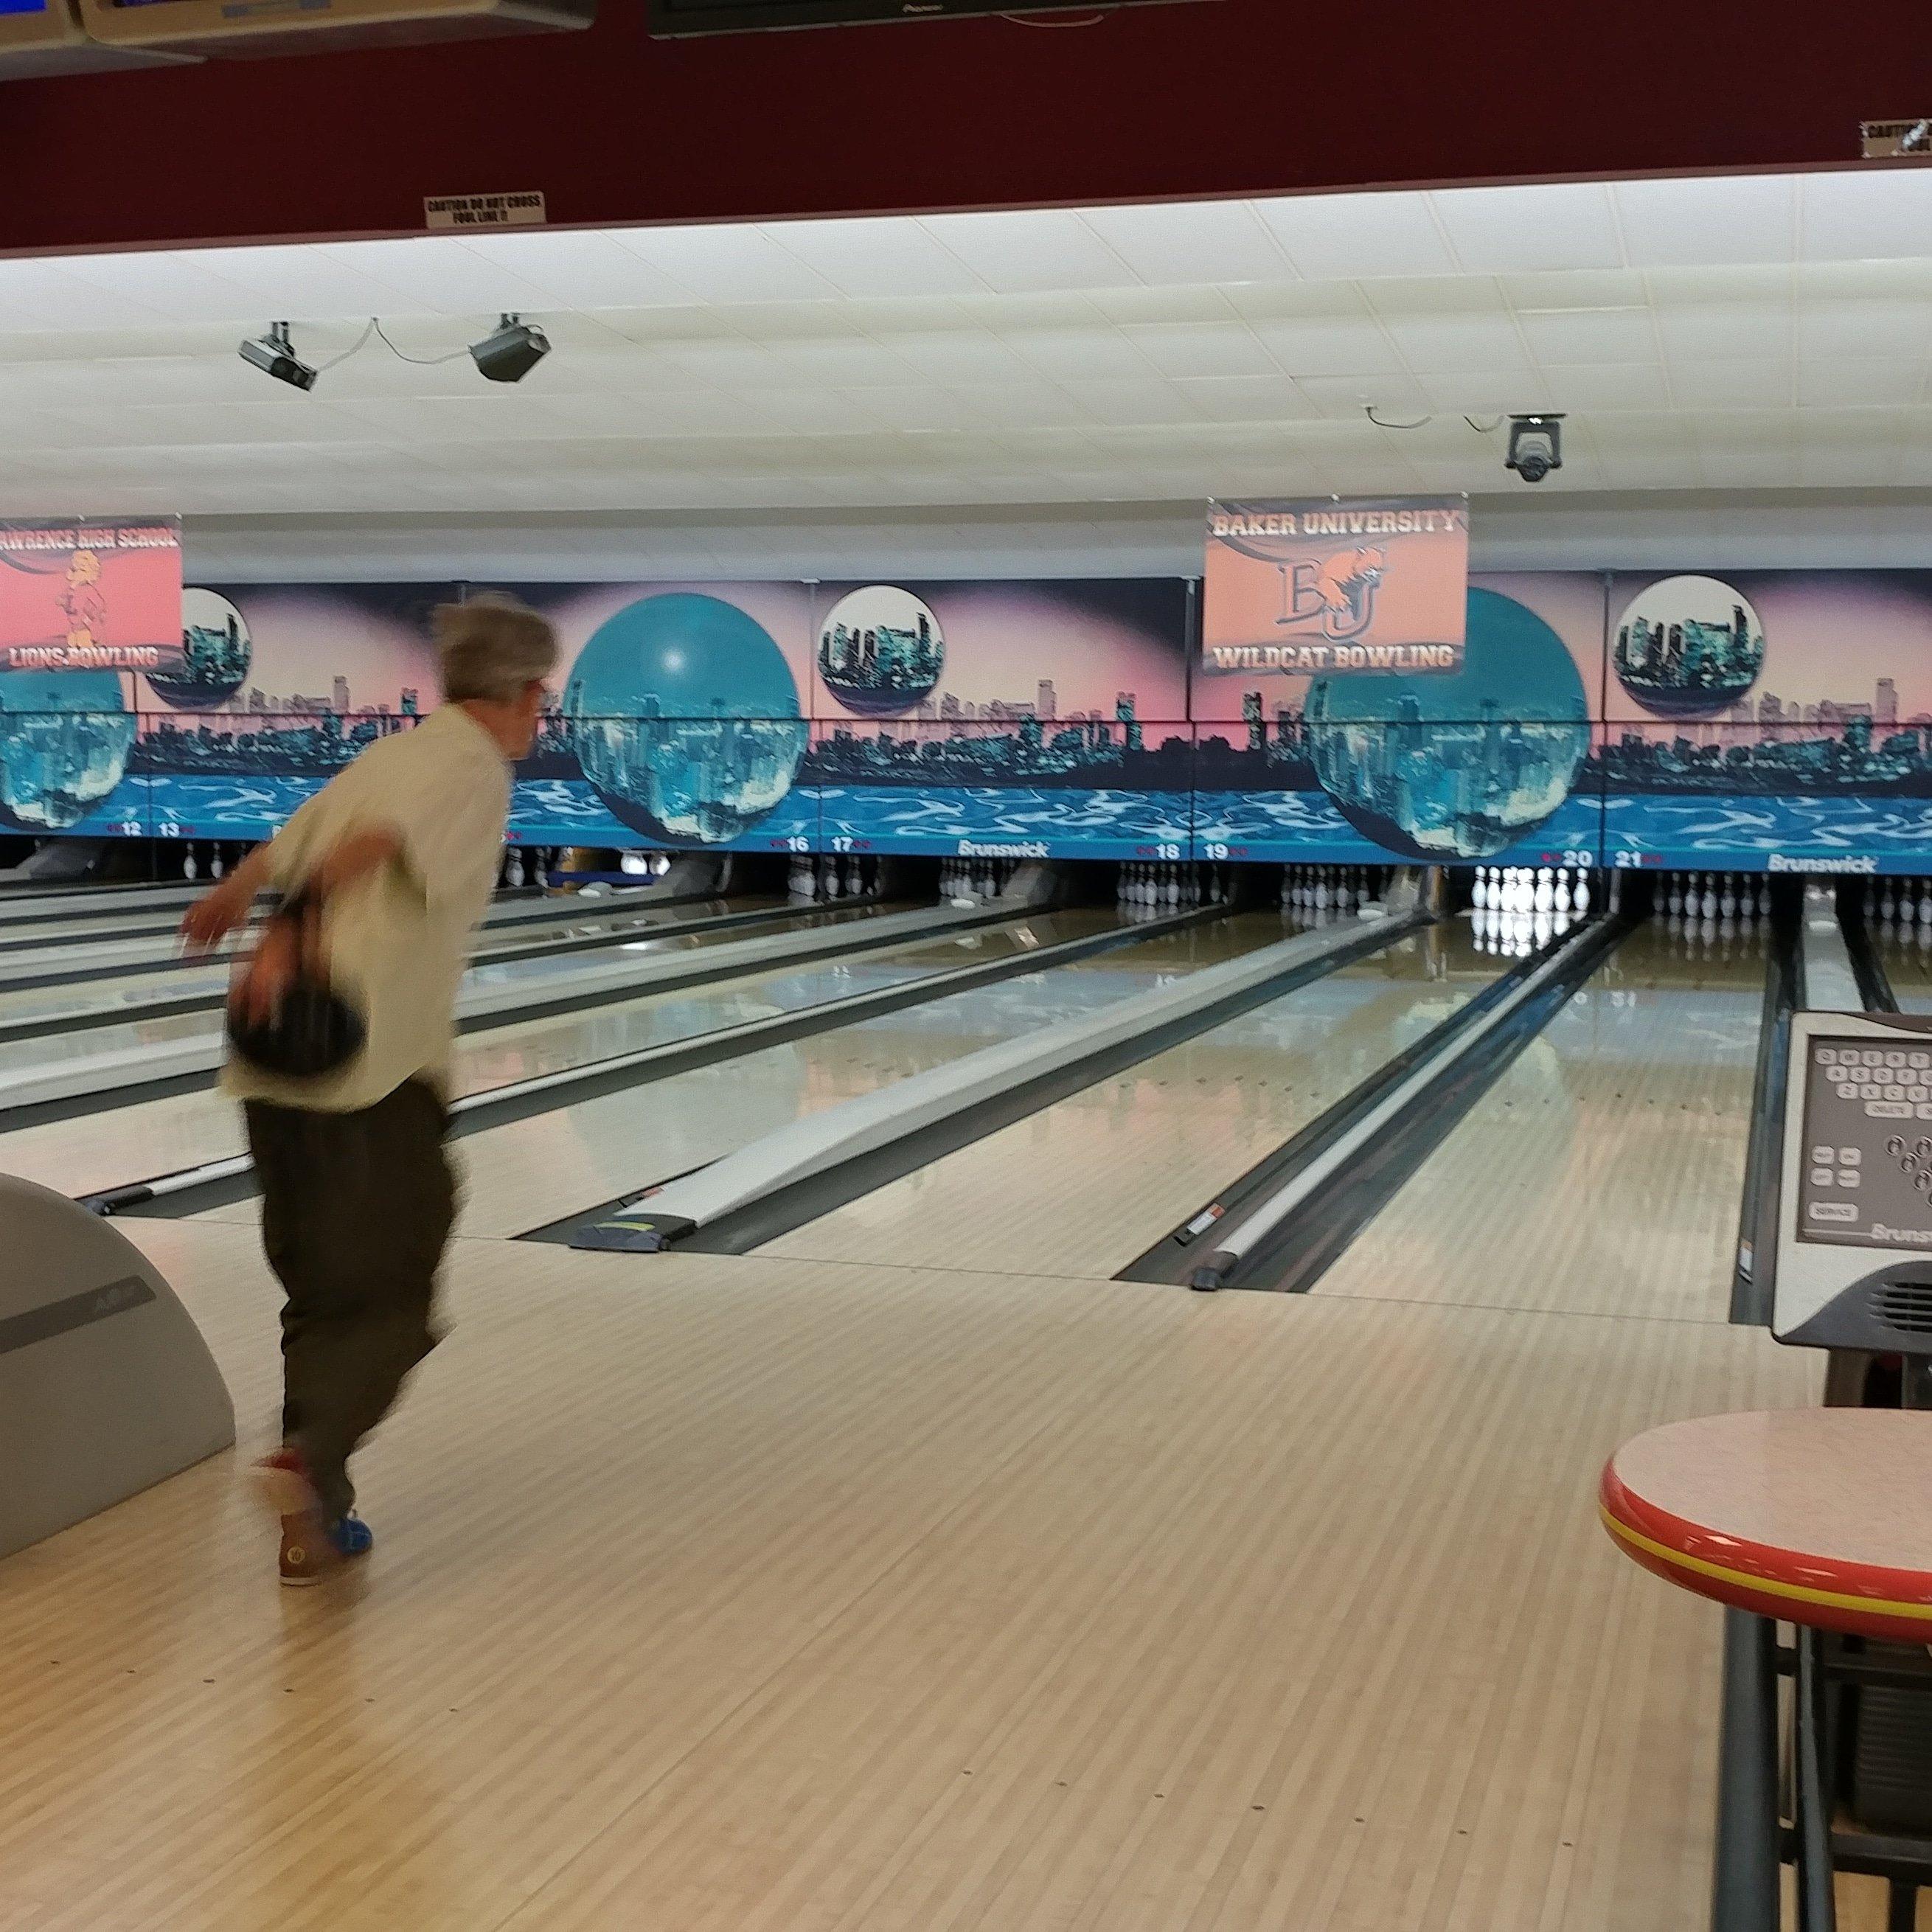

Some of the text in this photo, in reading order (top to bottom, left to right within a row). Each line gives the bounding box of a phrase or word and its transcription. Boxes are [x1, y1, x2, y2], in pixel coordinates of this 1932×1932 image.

[1212, 509, 1459, 537] BAKER UNIVERSITY
[76, 528, 117, 549] HIGH
[117, 527, 179, 548] SCHOOL
[9, 645, 159, 669] LIONS BOWLING
[1212, 644, 1456, 669] WILDCAT BOWLING
[159, 821, 180, 838] 13
[786, 835, 810, 852] 16
[830, 835, 854, 852] 17
[958, 839, 1052, 858] Brunswick
[1156, 843, 1181, 861] 18
[1203, 843, 1229, 861] 19
[1562, 849, 1594, 868] 20
[1615, 849, 1642, 868] 21
[1768, 853, 1880, 875] Brunswick
